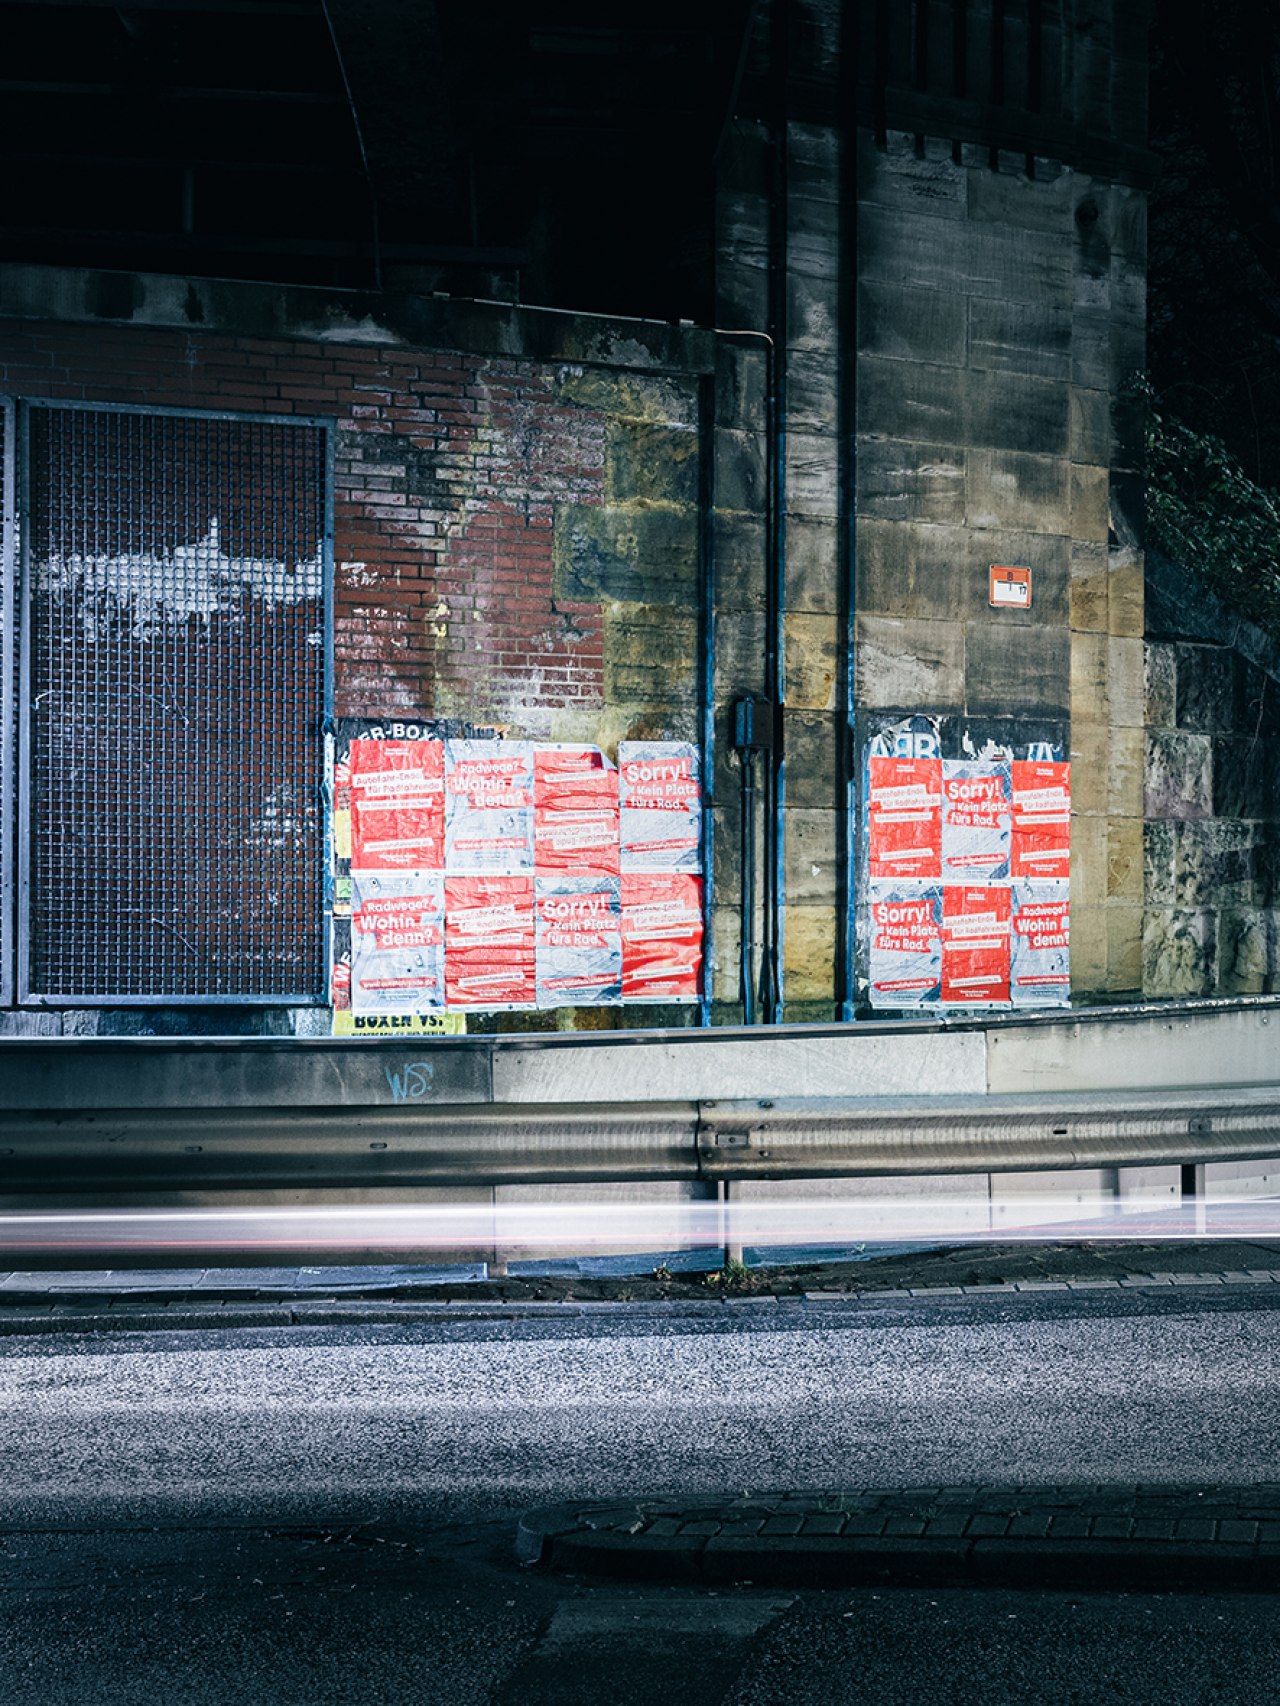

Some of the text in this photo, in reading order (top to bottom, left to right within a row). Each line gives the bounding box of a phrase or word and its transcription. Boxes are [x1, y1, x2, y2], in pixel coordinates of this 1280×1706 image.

[626, 761, 687, 782] Sorry!
[453, 777, 506, 792] Wohin
[637, 783, 697, 797] Kein Platz
[948, 782, 1000, 800] Sorry!
[474, 790, 523, 807] denn?
[657, 798, 684, 810] Rad.
[957, 802, 1007, 812] Kein Platz
[951, 813, 995, 826] fürs Rad.
[367, 899, 429, 913] Radwege?
[543, 895, 606, 918] Sorry!
[877, 902, 931, 924] Sorry!
[360, 914, 415, 930] Wohin
[584, 918, 616, 931] Platz
[1017, 916, 1058, 933] Wohin
[382, 928, 433, 946] denn?
[886, 925, 938, 937] Kein Platz
[546, 932, 600, 946] fürs Rad.
[879, 937, 925, 950] fürs Rad.
